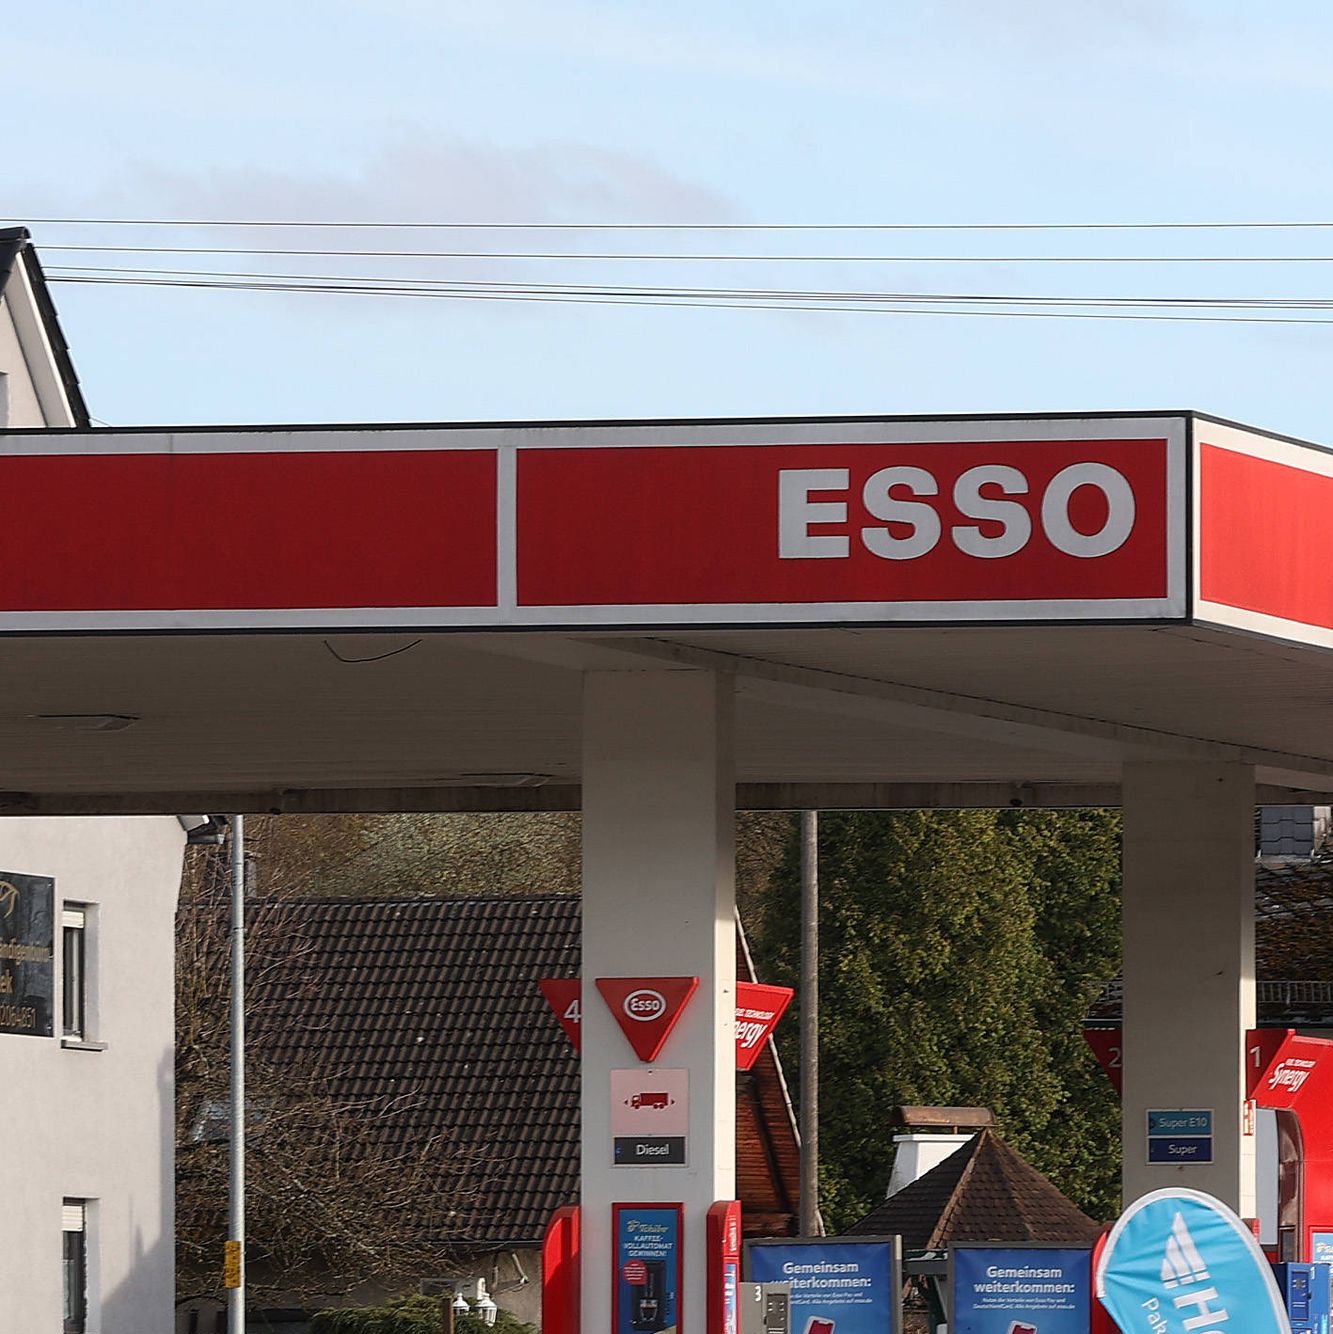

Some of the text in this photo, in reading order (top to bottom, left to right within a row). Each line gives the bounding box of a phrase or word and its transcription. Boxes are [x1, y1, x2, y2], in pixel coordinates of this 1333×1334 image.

[778, 461, 1137, 560] ESSO
[565, 1000, 582, 1023] 4
[630, 998, 660, 1012] Esso
[736, 1021, 768, 1048] nergy
[1108, 1047, 1122, 1068] 2
[1250, 1046, 1261, 1067] 1
[1268, 1062, 1310, 1092] Synergy
[1159, 1117, 1208, 1129] Super E10
[636, 1144, 670, 1156] Diesel
[1168, 1144, 1197, 1155] Super
[783, 1261, 859, 1274] Gemeinsam
[987, 1266, 1062, 1278] Gemeinsam
[771, 1276, 872, 1288] iterkommen:
[974, 1281, 1075, 1293] weiterkommen:
[755, 1286, 762, 1302] 3
